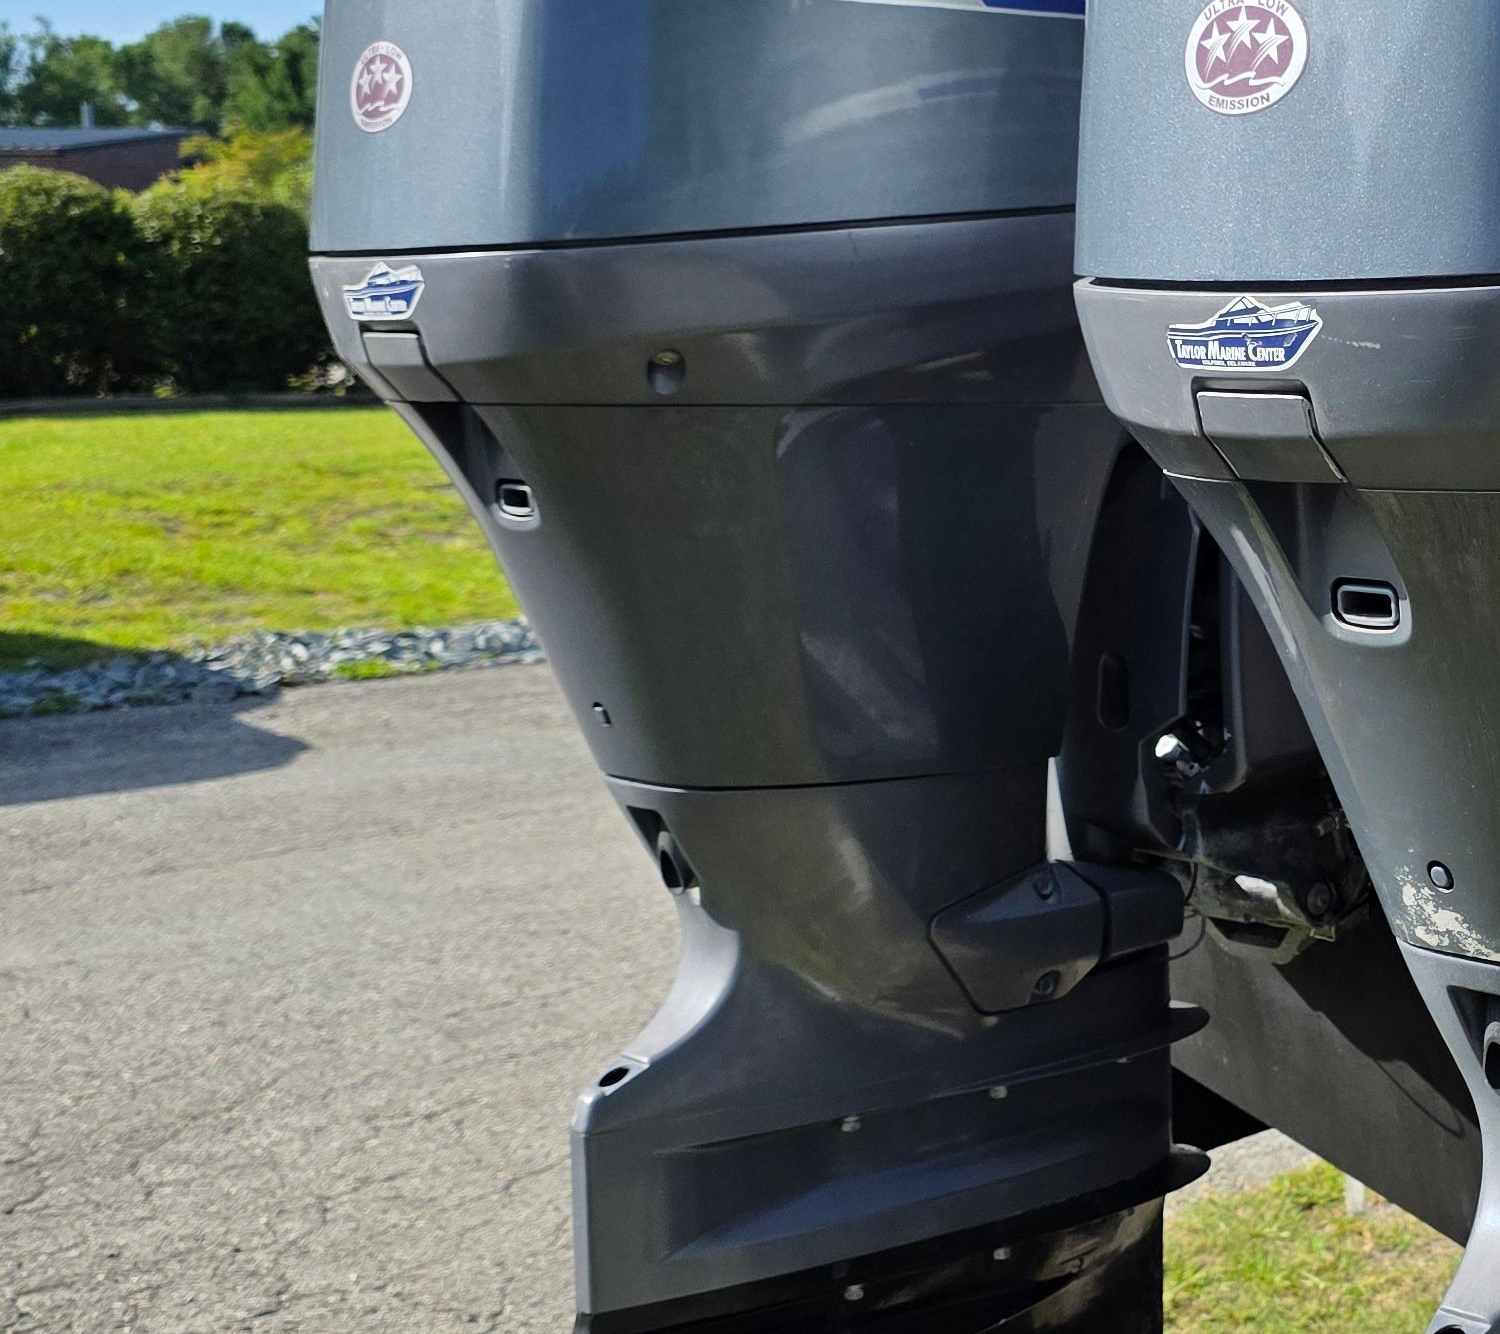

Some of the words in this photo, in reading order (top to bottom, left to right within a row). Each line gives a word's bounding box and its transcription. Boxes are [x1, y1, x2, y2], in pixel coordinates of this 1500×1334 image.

[1208, 93, 1271, 110] EMISSION
[1174, 339, 1207, 360] TAYLOR
[1207, 340, 1246, 361] MARINE
[1247, 339, 1286, 362] CENTER
